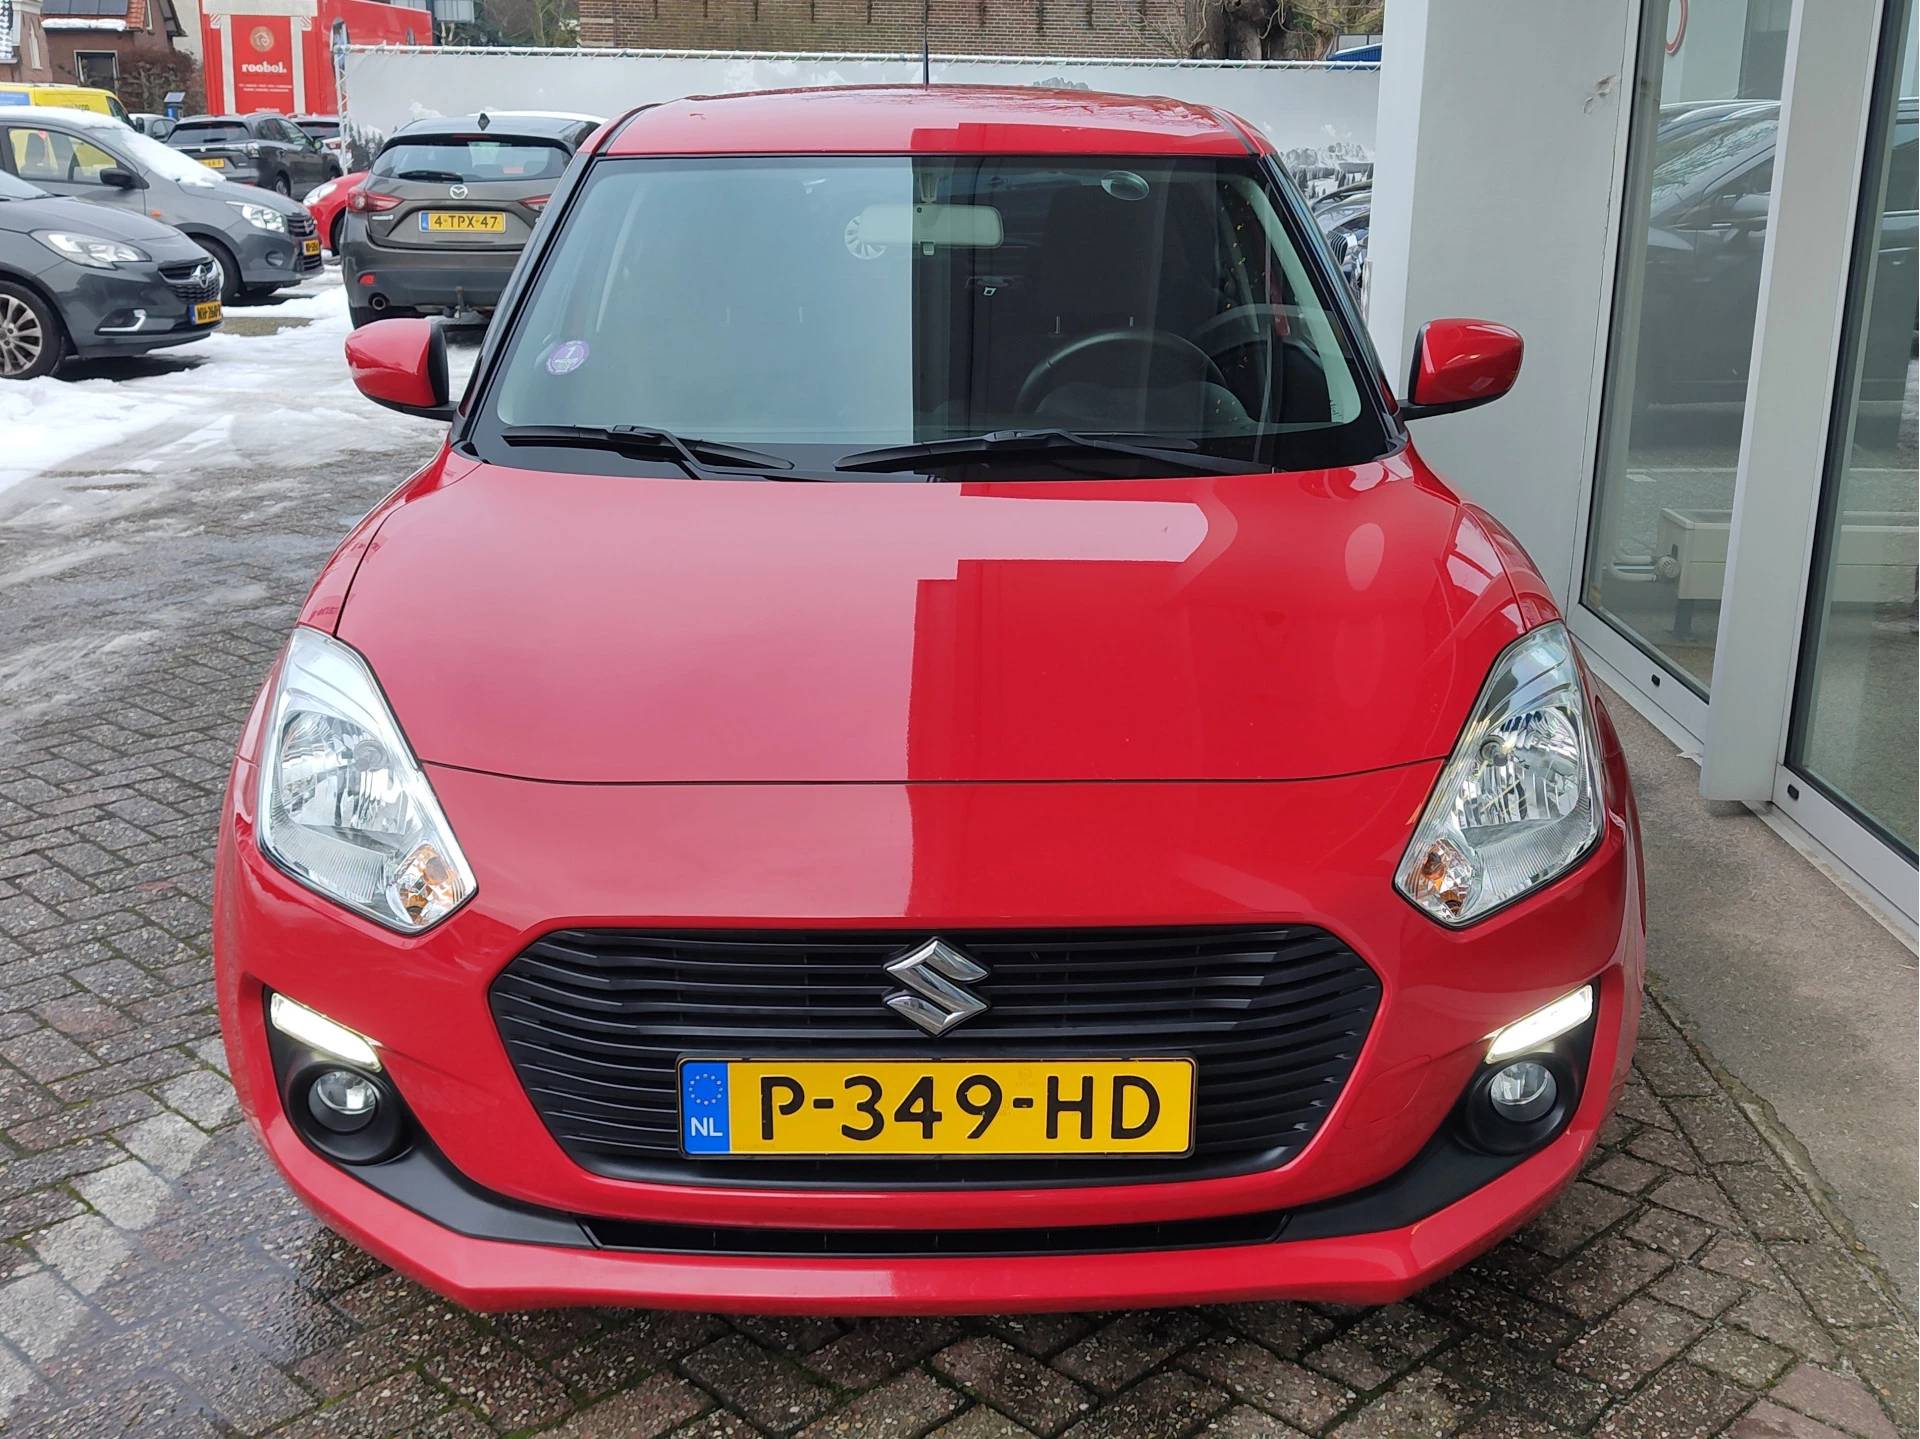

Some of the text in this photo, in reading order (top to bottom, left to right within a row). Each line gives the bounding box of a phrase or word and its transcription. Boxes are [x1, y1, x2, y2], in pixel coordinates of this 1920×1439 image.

[434, 215, 498, 229] 4-TPX-47
[760, 1075, 1161, 1141] P-349-HD
[690, 1117, 723, 1137] NL
